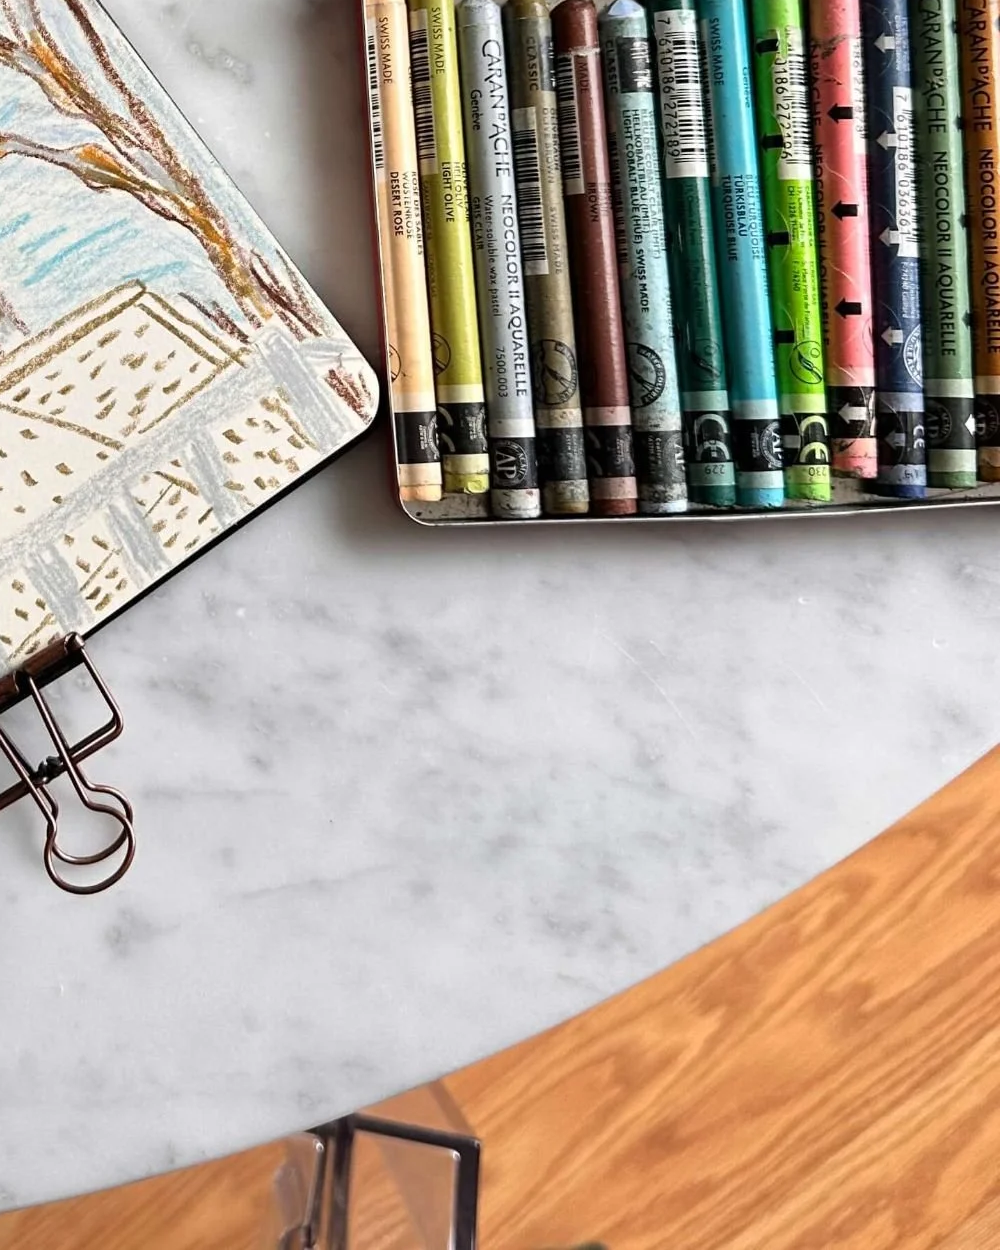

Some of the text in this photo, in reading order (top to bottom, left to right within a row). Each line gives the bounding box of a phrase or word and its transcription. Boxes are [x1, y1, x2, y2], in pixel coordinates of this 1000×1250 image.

[378, 16, 393, 85] SWISS MADE
[431, 7, 445, 75] SWISS MADE
[481, 39, 505, 109] CARAN
[525, 36, 539, 92] CLASSIC
[604, 40, 618, 94] CLASSIC
[709, 17, 725, 86] SWISS MADE
[470, 89, 483, 131] Genève
[578, 62, 590, 95] MADE
[657, 17, 681, 158] 7 610186 272189
[896, 114, 911, 171] 610186
[389, 171, 404, 237] DESERT ROSE
[441, 161, 455, 223] LIGHT OLIVE
[587, 182, 599, 223] BROWN
[622, 109, 643, 244] LIGHT COBALT BLUE (HUE)
[897, 179, 912, 237] 036361
[932, 151, 951, 243] NEOCOLOR
[978, 149, 998, 240] NEOCOLOR
[472, 196, 485, 251] GRIS CLAIR
[501, 194, 520, 285] NEOCOLOR
[721, 175, 738, 262] TURQUOISE BLUE
[634, 249, 650, 314] SWISS MADE
[937, 249, 951, 258] II
[483, 195, 508, 398] Water-soluble wax pastel 7500.003
[508, 289, 521, 299] II
[936, 262, 956, 357] AQUARELLE
[984, 259, 1000, 354] AQUARELLE
[509, 304, 528, 397] AQUARELLE
[703, 464, 726, 475] 229
[808, 466, 828, 477] 230
